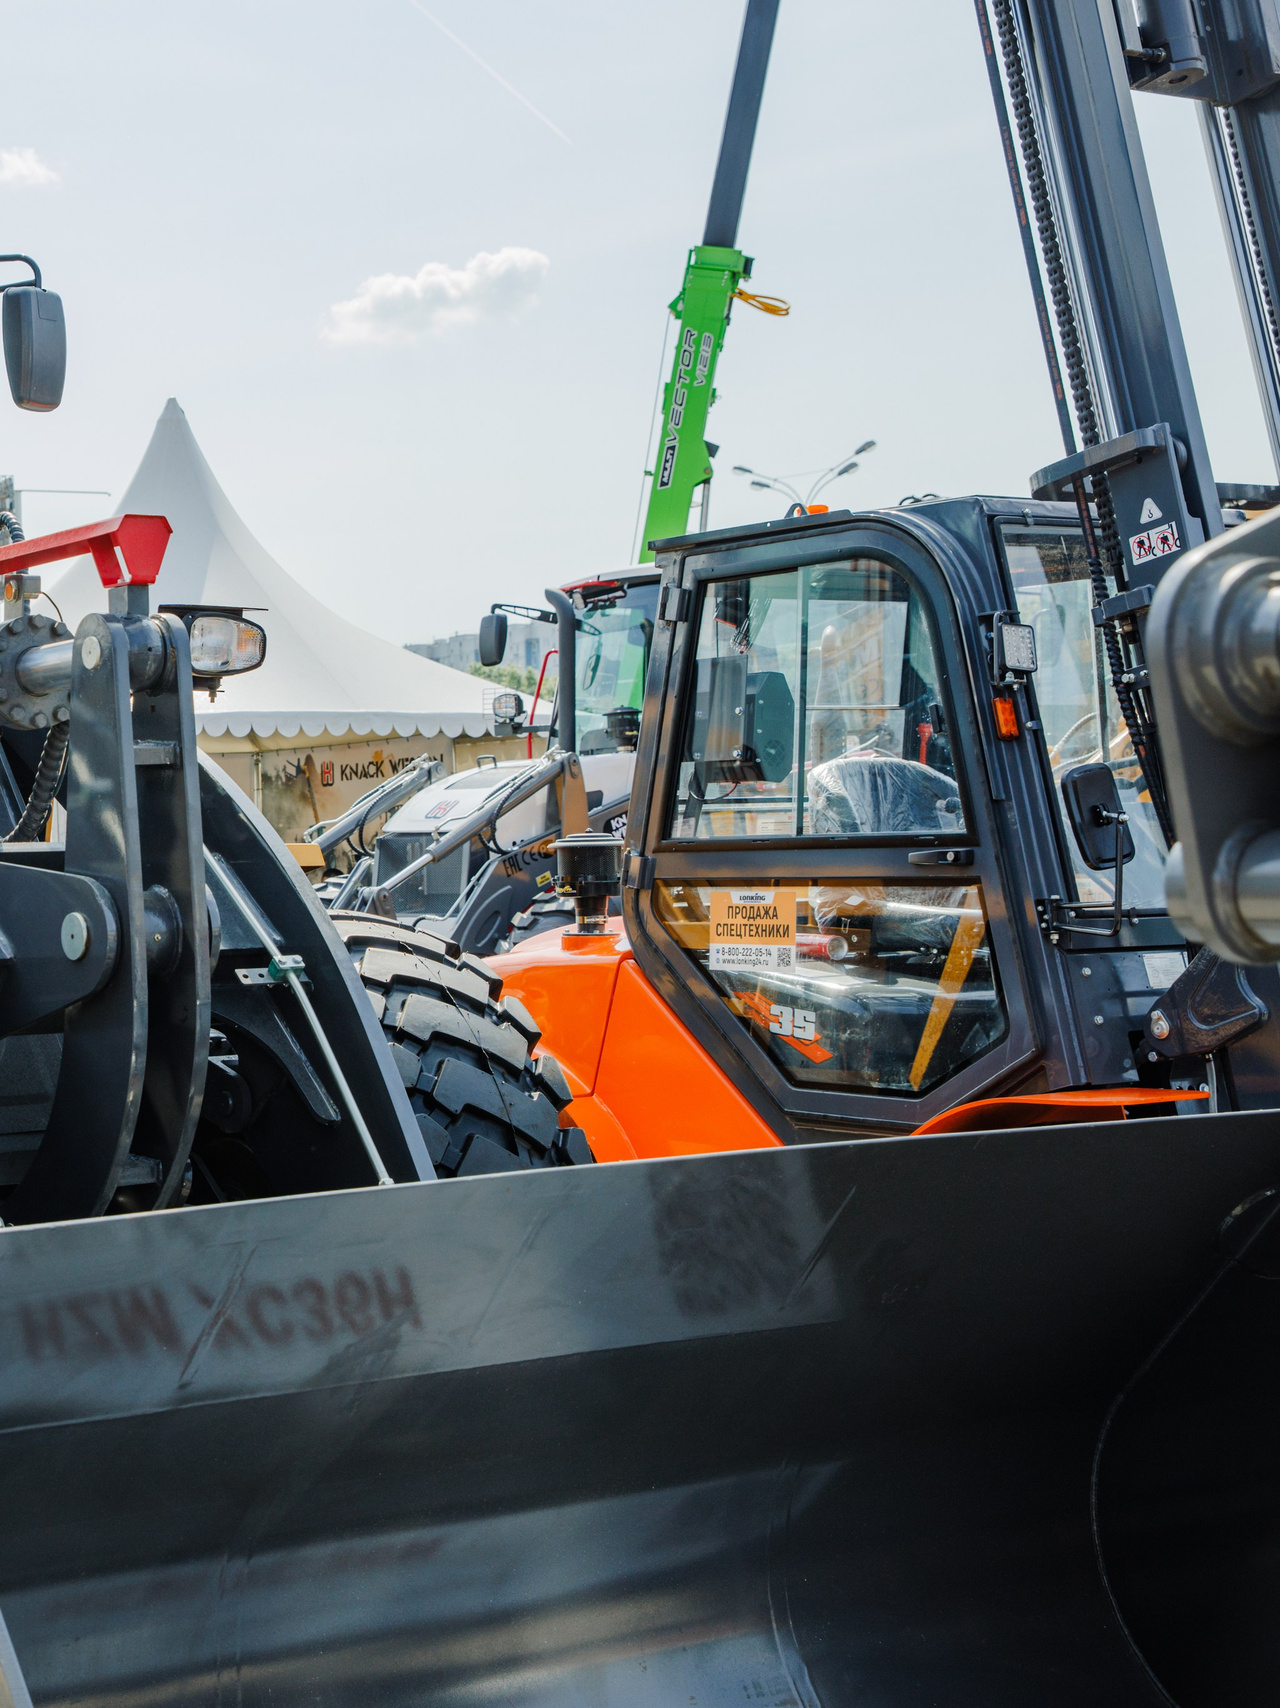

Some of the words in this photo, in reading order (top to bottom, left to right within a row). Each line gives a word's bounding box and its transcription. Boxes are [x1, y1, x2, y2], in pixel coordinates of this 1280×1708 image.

[666, 328, 697, 443] VECTOR
[340, 760, 385, 781] KNACK
[727, 906, 779, 921] ПРОДАЖА
[716, 923, 790, 939] СПЕЦТЕХНИКИ
[721, 947, 772, 957] 8-800-222-05-14
[722, 957, 769, 967] www.lonking24.ru
[769, 1004, 816, 1041] 35
